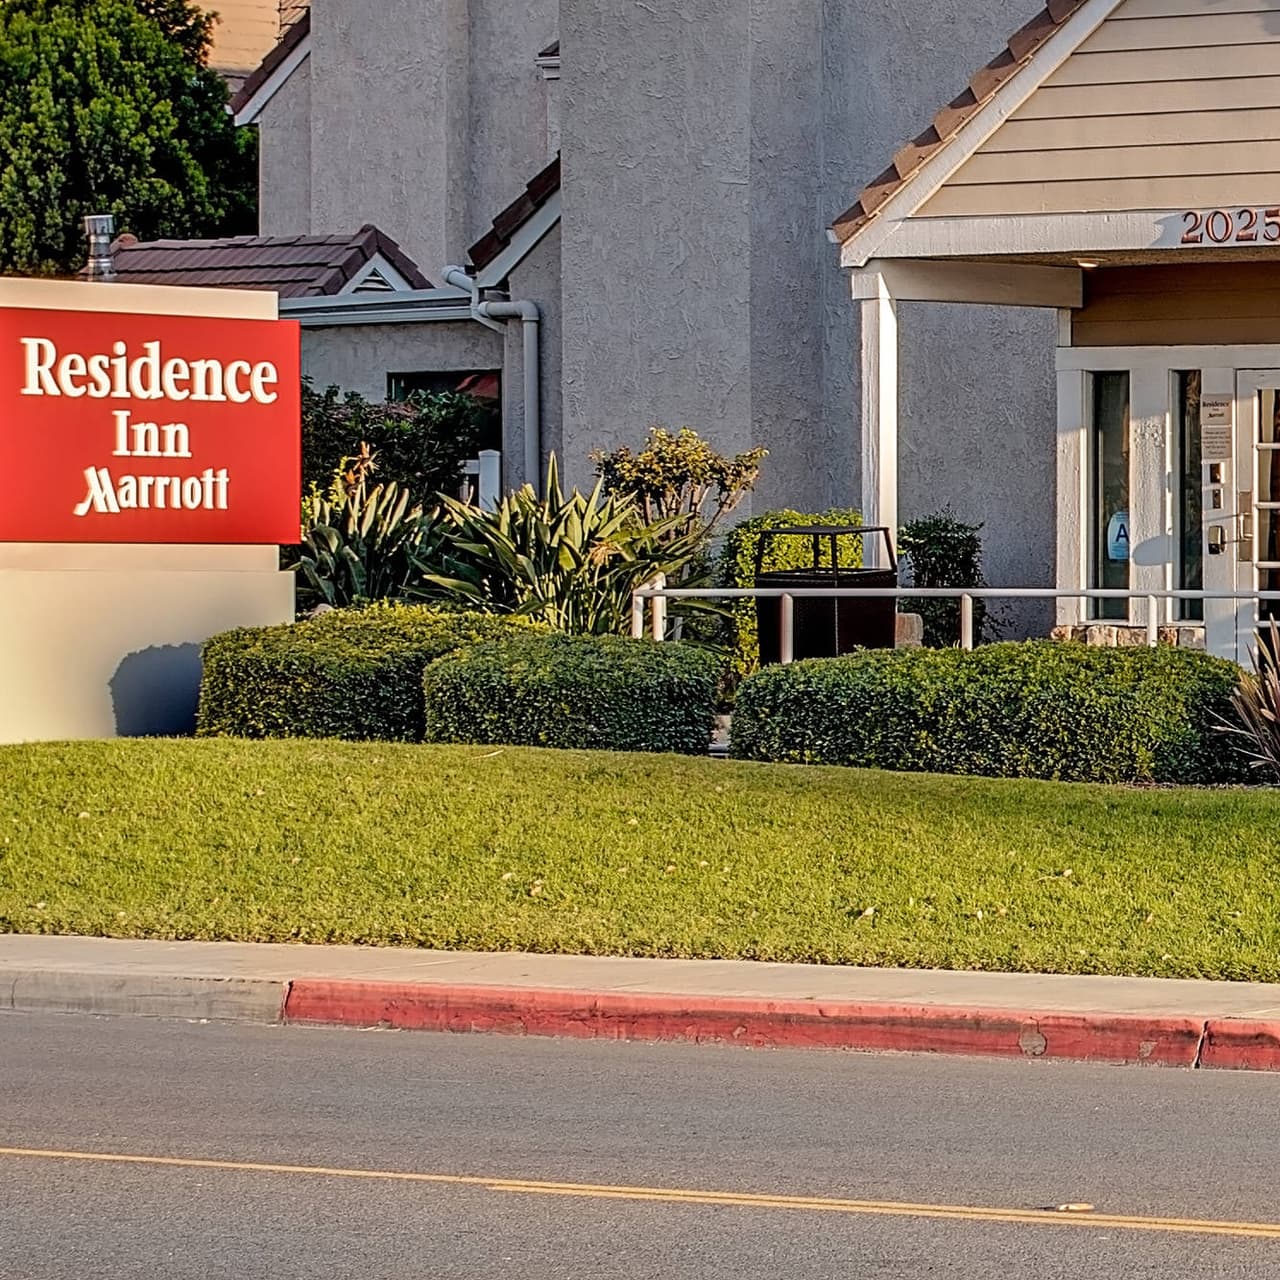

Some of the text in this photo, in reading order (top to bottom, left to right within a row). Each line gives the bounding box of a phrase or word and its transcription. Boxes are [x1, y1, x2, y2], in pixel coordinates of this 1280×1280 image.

[20, 337, 278, 403] Residence
[112, 410, 192, 458] Inn
[73, 466, 230, 517] Marriott
[1116, 523, 1129, 542] A
